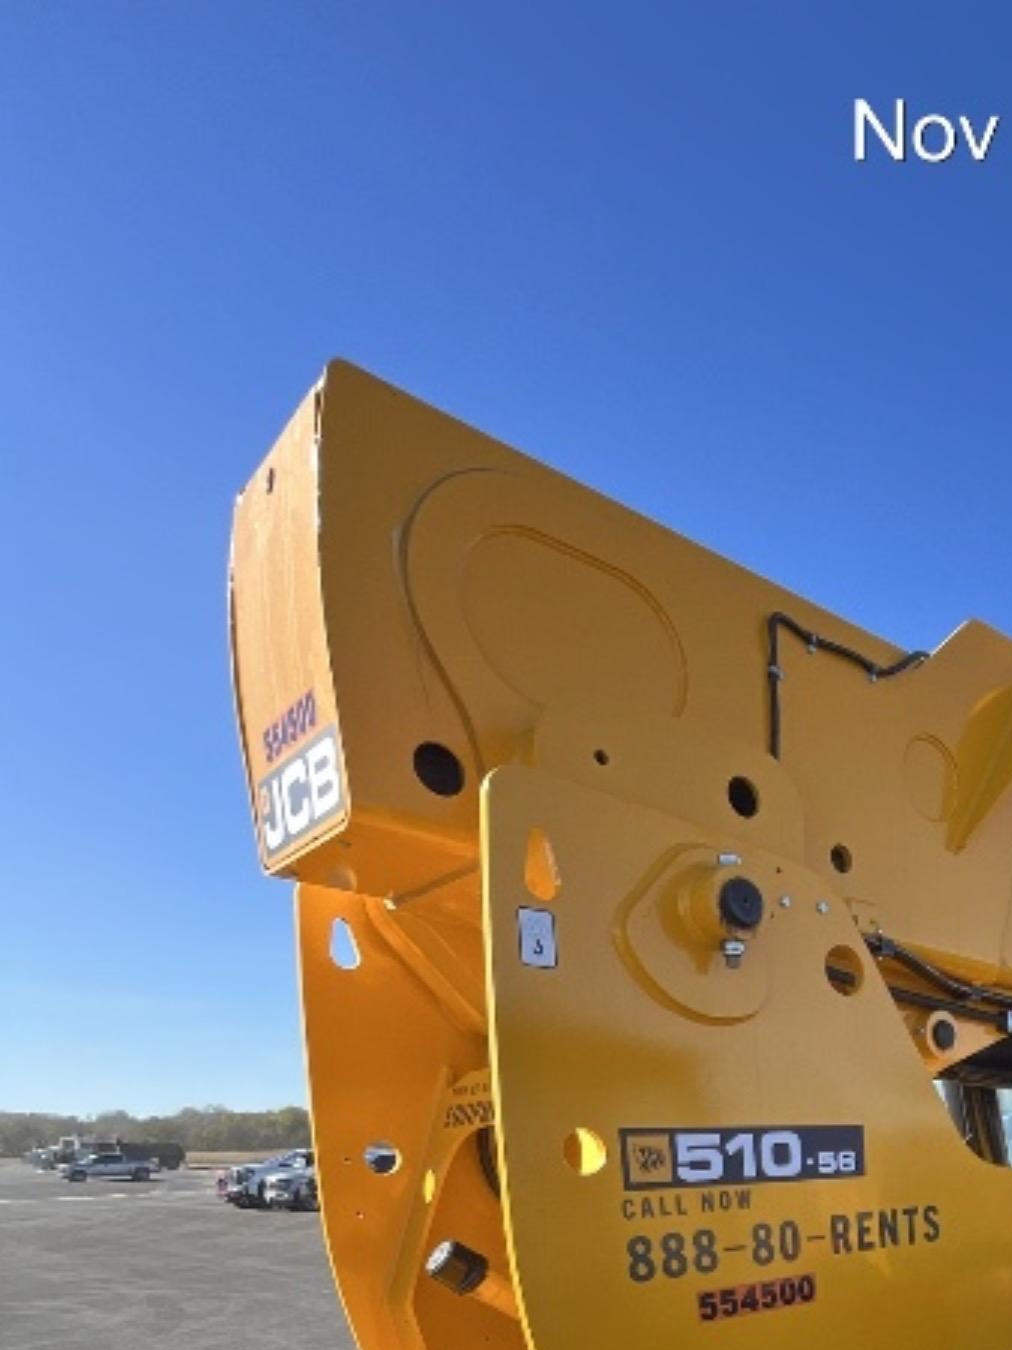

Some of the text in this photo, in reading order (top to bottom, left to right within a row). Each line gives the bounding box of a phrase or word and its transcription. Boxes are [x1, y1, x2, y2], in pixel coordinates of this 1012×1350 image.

[264, 736, 340, 850] JCB
[622, 1190, 752, 1221] CALL NOW
[626, 1205, 941, 1283] 888-80-RENTS
[699, 1274, 817, 1322] 554500
